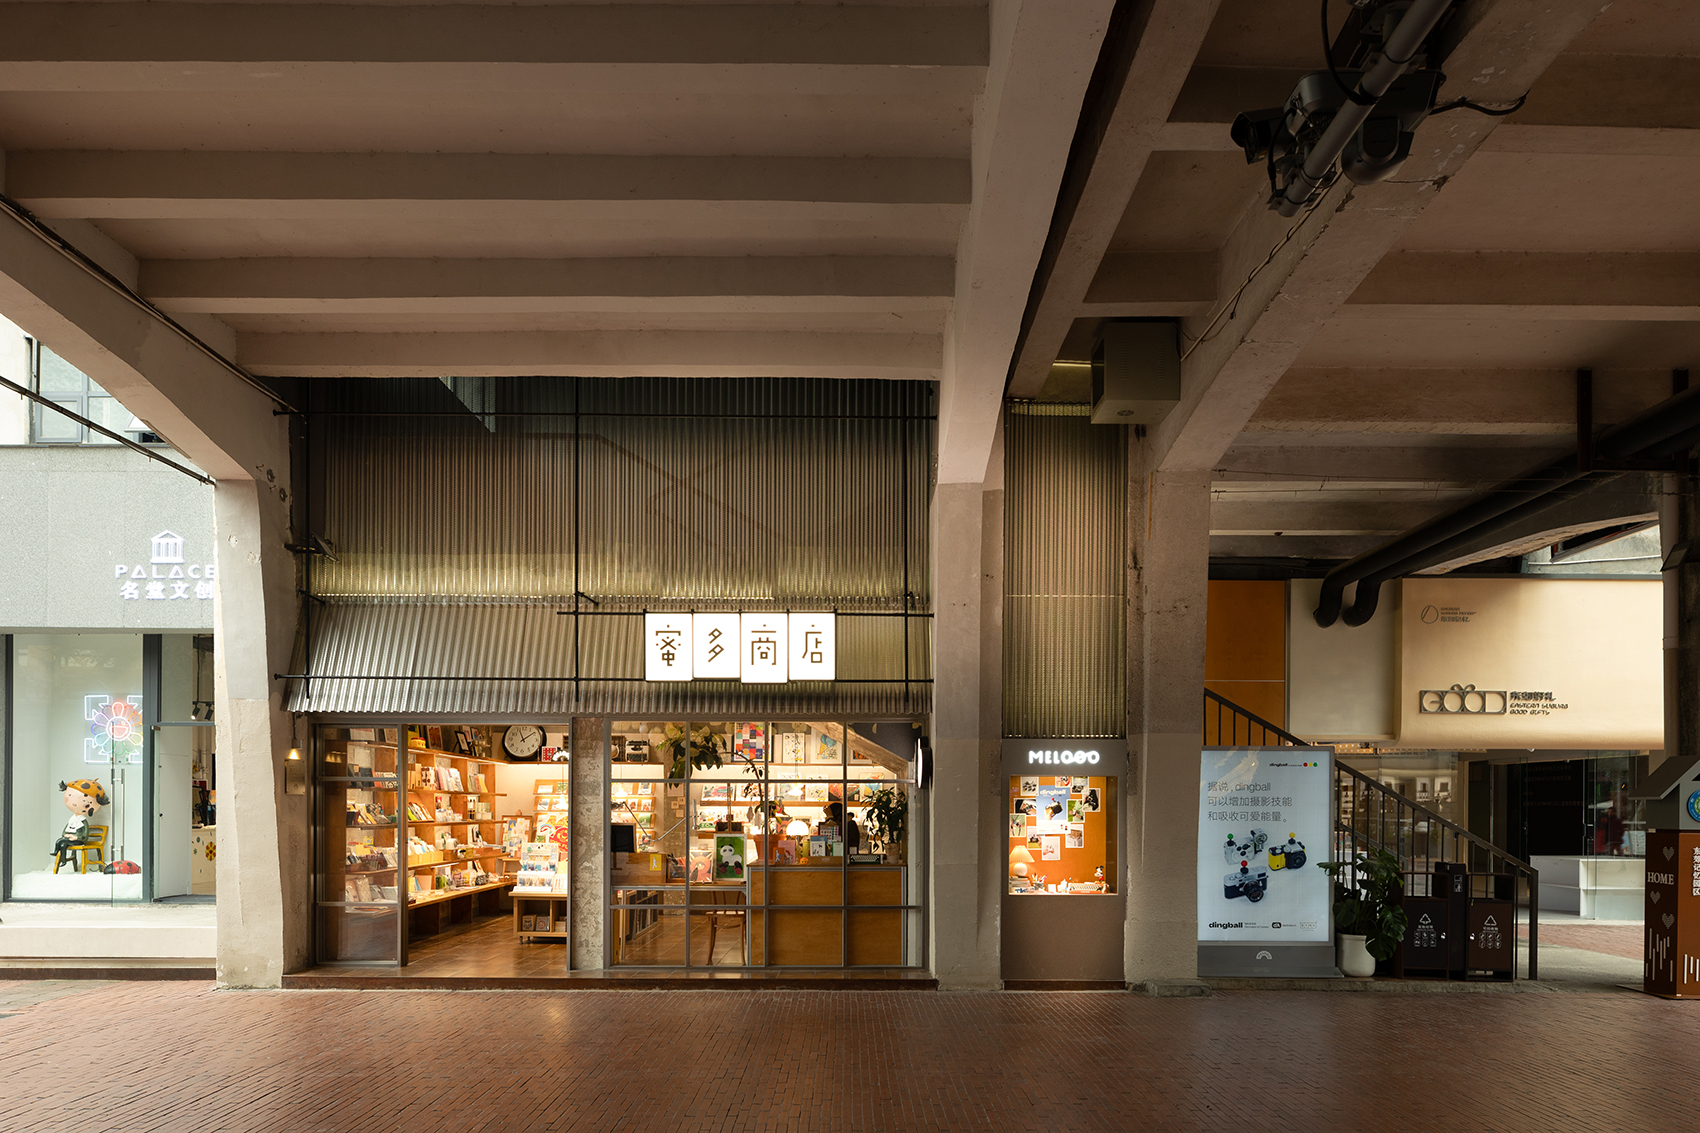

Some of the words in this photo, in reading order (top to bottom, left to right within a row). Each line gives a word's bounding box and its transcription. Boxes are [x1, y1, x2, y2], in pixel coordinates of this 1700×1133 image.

[114, 564, 214, 580] PALACE
[656, 624, 823, 666] 蜜多商店
[1208, 796, 1292, 806] 可以增加摄影技能
[1647, 872, 1674, 885] HOME
